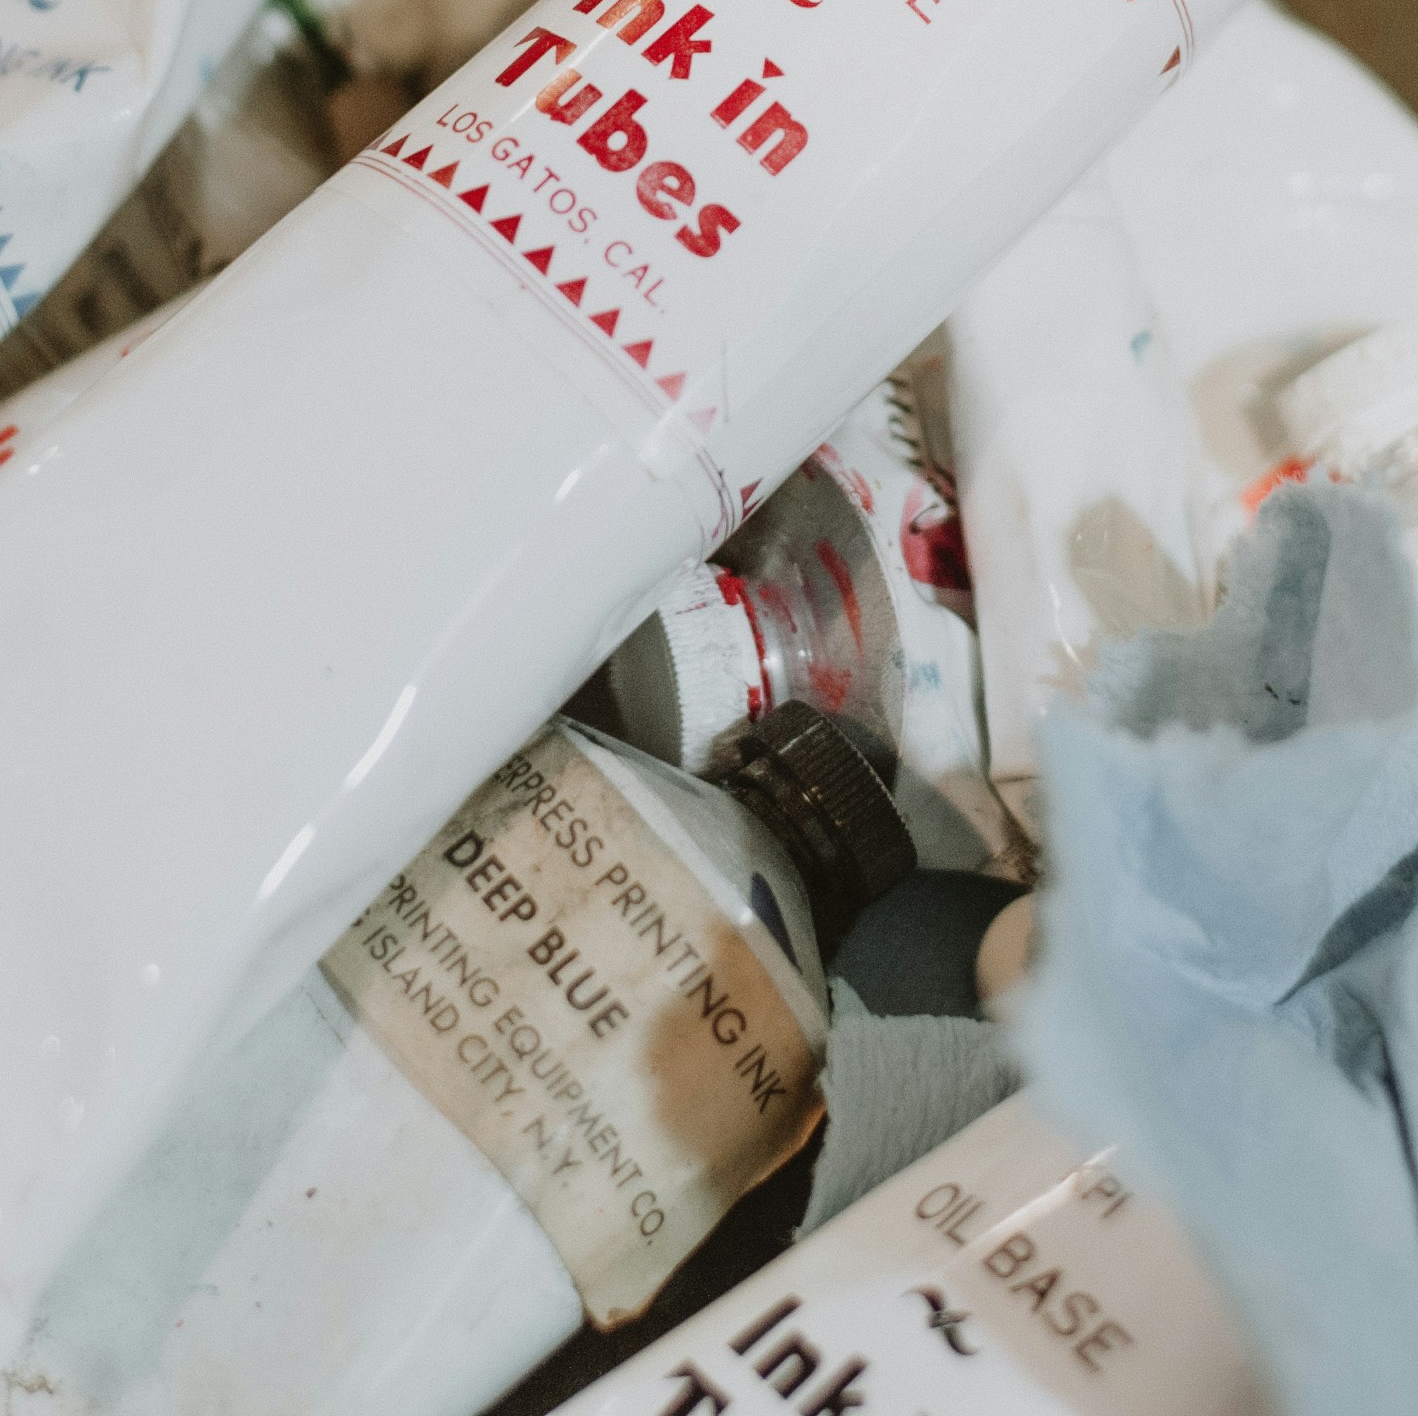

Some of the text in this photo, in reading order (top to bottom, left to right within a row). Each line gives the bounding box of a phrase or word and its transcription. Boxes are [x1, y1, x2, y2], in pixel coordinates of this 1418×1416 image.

[435, 103, 494, 144] LOS
[603, 240, 667, 316] CAL.
[494, 26, 742, 258] Tubes
[710, 56, 809, 177] in
[441, 829, 631, 1040] DEEP BLUE
[593, 860, 749, 1047] PRINTING
[733, 1041, 789, 1115] INK
[361, 924, 583, 1188] ISLAND CITY, N.Y.
[493, 1004, 644, 1190] EQUIPMENT
[629, 1188, 666, 1246] CO.
[727, 1292, 871, 1416] Ink
[914, 1181, 1136, 1374] OIL BASE
